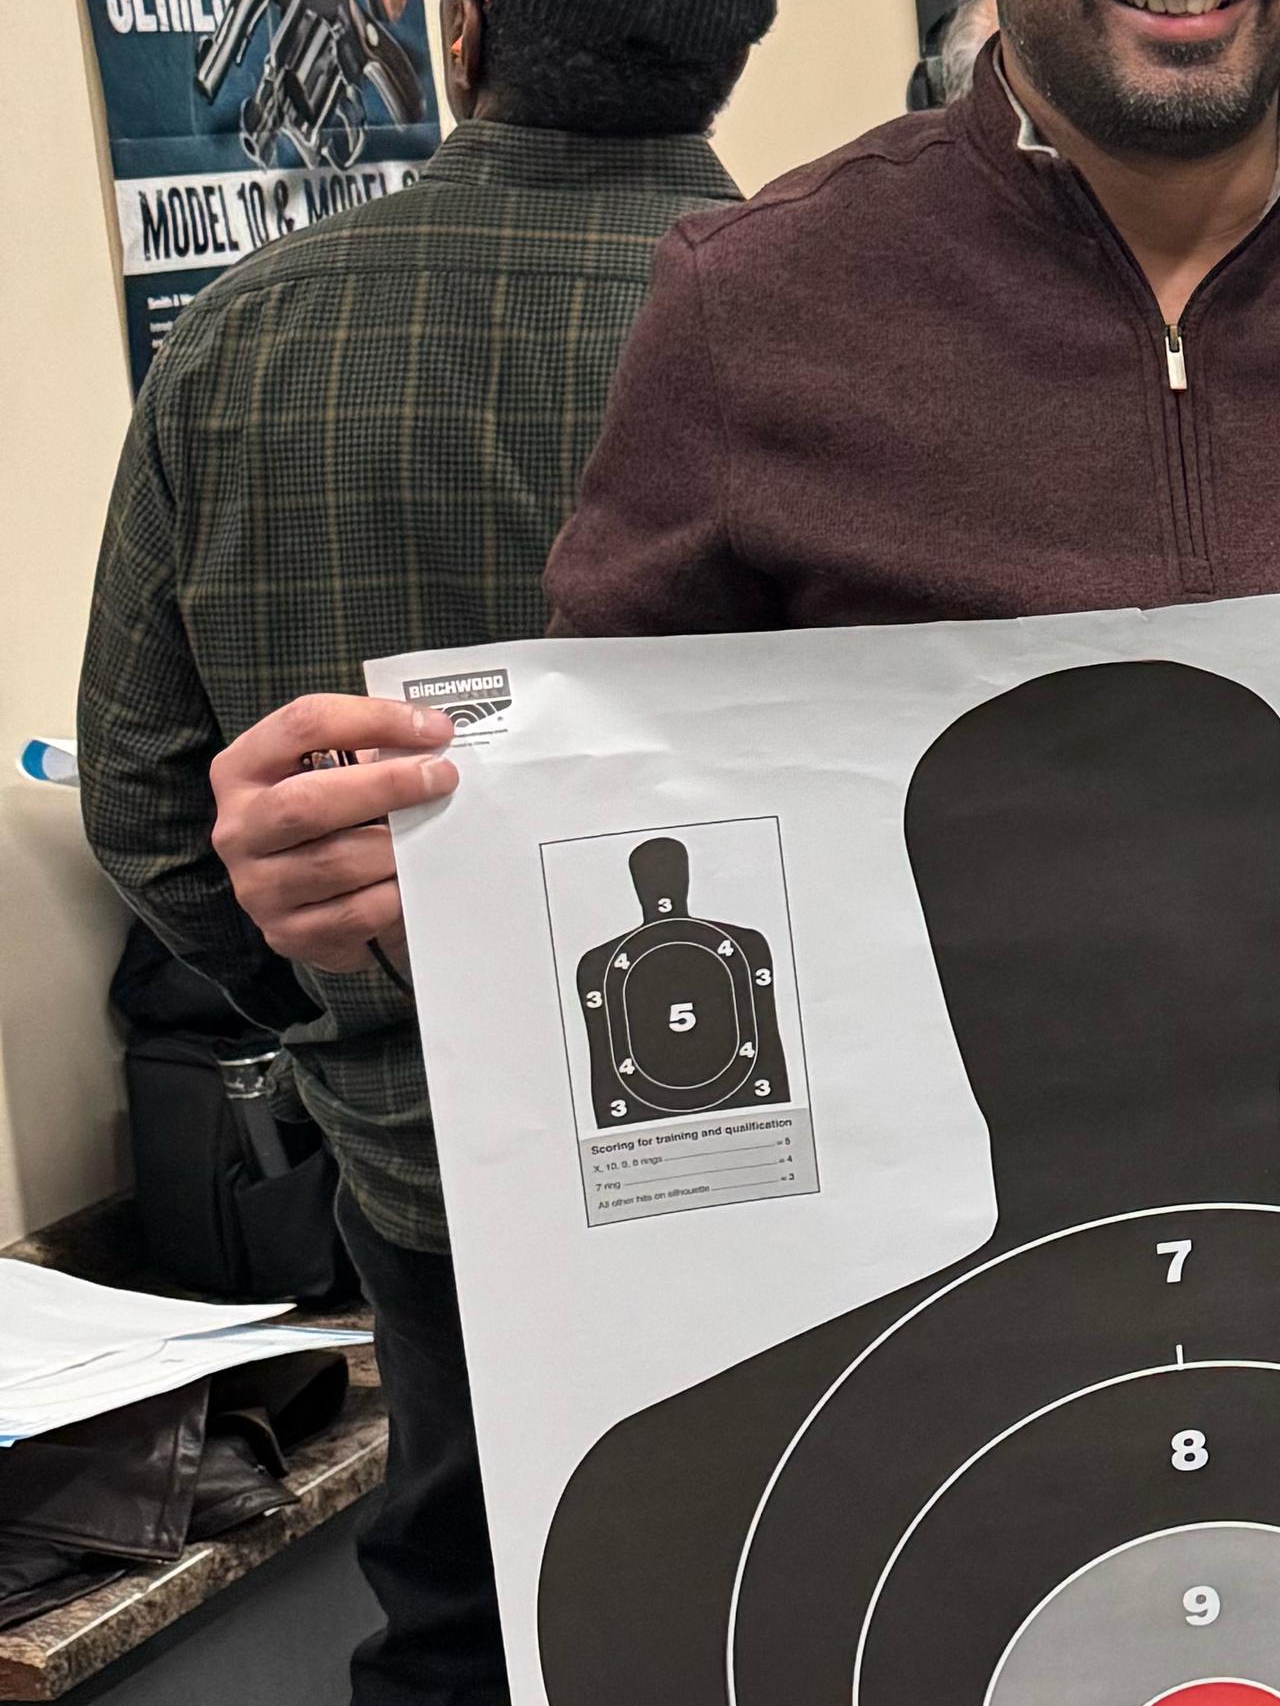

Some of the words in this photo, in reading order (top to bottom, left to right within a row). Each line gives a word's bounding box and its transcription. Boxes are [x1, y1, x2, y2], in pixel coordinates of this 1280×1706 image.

[139, 184, 239, 262] MODEL
[658, 898, 672, 913] 3
[717, 940, 734, 957] 4
[614, 953, 630, 970] 4
[755, 968, 772, 986] 3
[586, 991, 603, 1008] 3
[669, 1002, 697, 1032] 5
[739, 1042, 755, 1058] 4
[619, 1058, 635, 1075] 4
[754, 1079, 771, 1096] 3
[610, 1100, 627, 1117] 3
[591, 1140, 635, 1156] Scoring
[637, 1137, 653, 1147] for
[655, 1129, 699, 1145] training
[701, 1127, 722, 1138] and
[725, 1118, 793, 1135] qualification
[1156, 1238, 1194, 1284] 7
[1171, 1429, 1210, 1473] 8
[1181, 1585, 1222, 1627] 9
